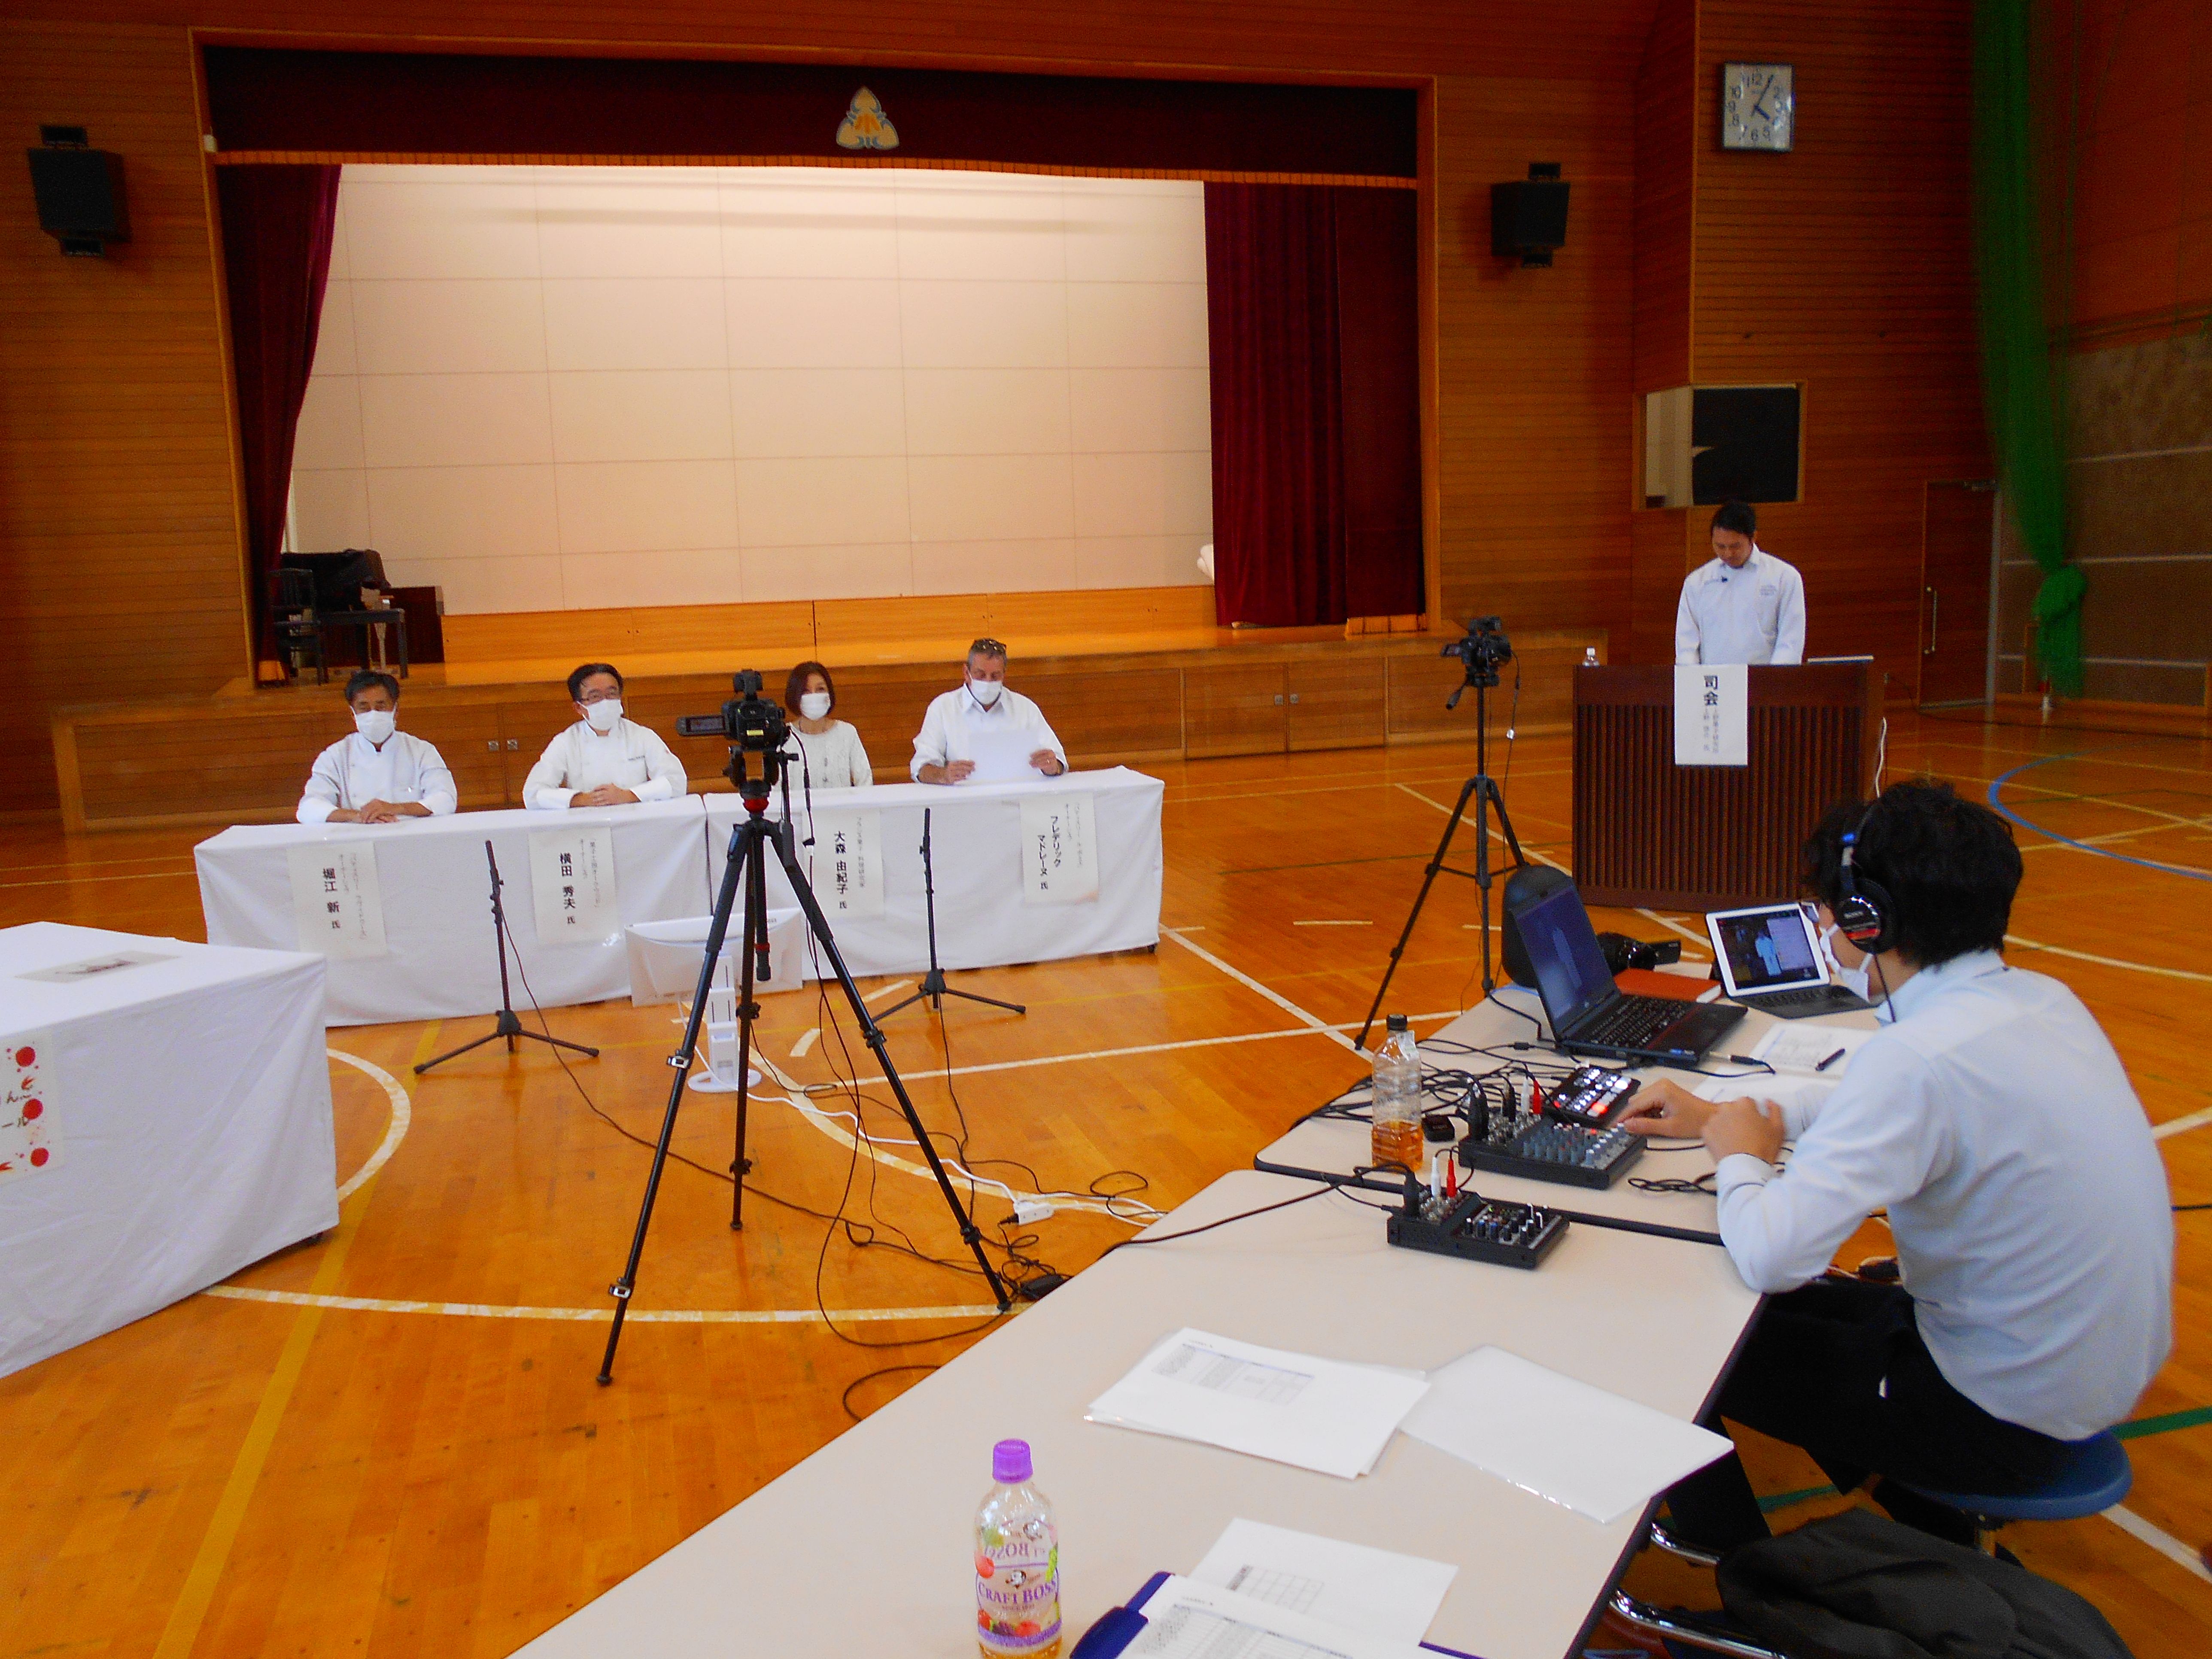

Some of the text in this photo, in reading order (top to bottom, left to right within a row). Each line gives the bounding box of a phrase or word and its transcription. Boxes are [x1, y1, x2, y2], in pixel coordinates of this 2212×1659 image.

[1752, 73, 1762, 85] 12
[1751, 129, 1758, 141] 6
[1704, 675, 1718, 706] 司会
[834, 830, 846, 854] 大森
[1051, 816, 1061, 868] フレデリック
[560, 852, 572, 877] 横田
[1038, 835, 1047, 877] マドレーヌ
[322, 868, 338, 892] 堀江
[836, 860, 848, 894] 由紀子
[327, 901, 340, 913] 新
[563, 884, 576, 909] 秀夫
[978, 1582, 1018, 1604] CRAFT
